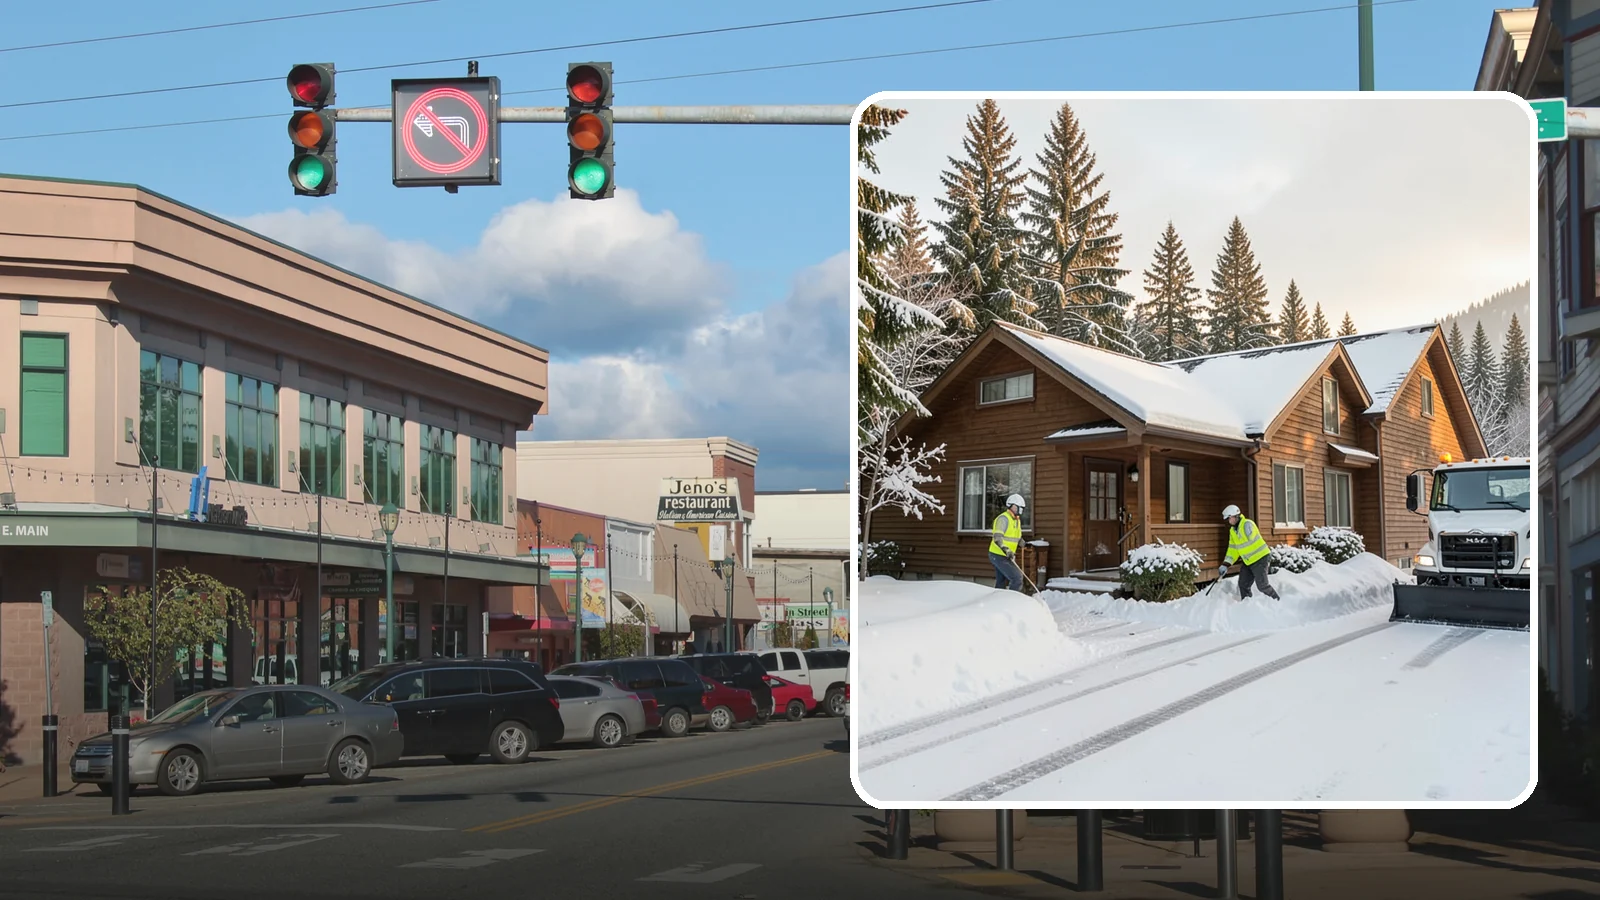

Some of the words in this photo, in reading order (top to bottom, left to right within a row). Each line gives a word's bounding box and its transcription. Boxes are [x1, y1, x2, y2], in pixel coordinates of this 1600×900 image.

[669, 480, 728, 496] Jeno's
[665, 496, 731, 509] restaurant
[686, 509, 715, 520] American
[715, 509, 738, 520] Cuisine
[2, 525, 13, 536] E.
[15, 525, 49, 536] MAIN
[797, 607, 828, 617] Street
[791, 619, 823, 628] lass
